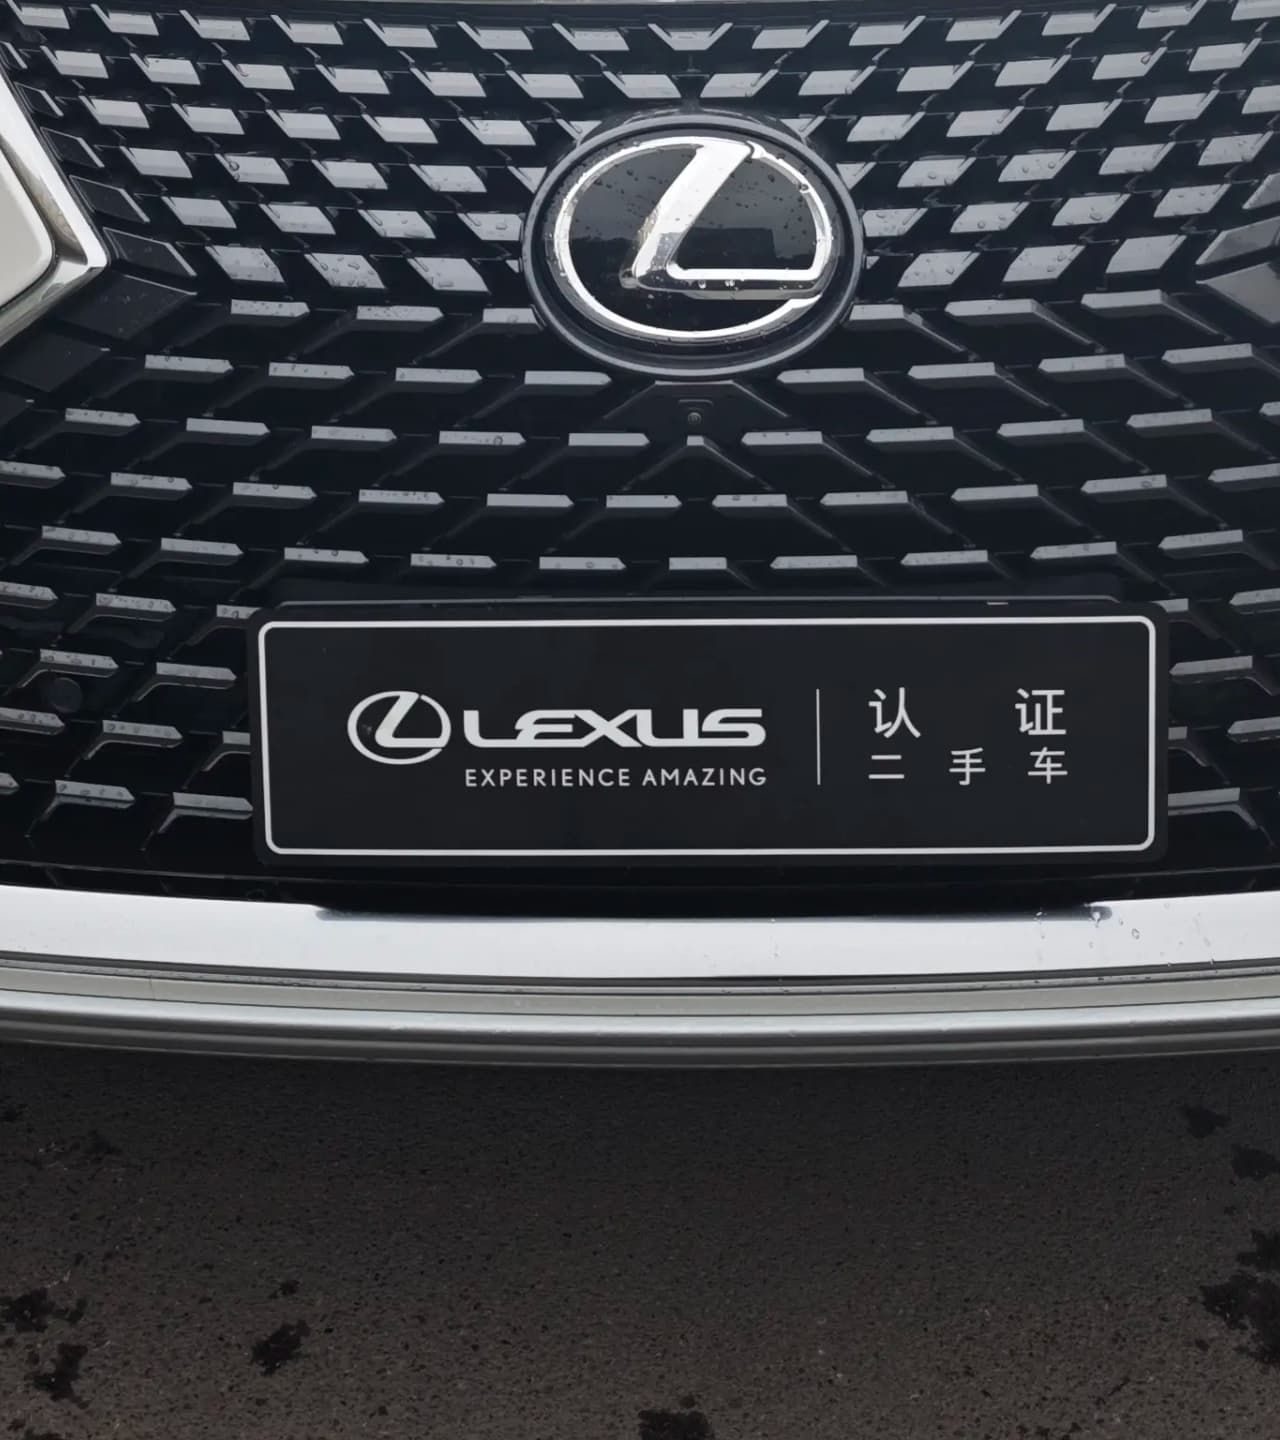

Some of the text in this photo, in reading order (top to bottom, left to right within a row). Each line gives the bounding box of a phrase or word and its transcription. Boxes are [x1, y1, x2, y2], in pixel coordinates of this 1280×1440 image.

[463, 708, 767, 748] LEXUS
[868, 686, 1068, 738] 认证
[465, 766, 767, 787] EXPERIENCE AMAZING
[868, 746, 1069, 786] 二手车
